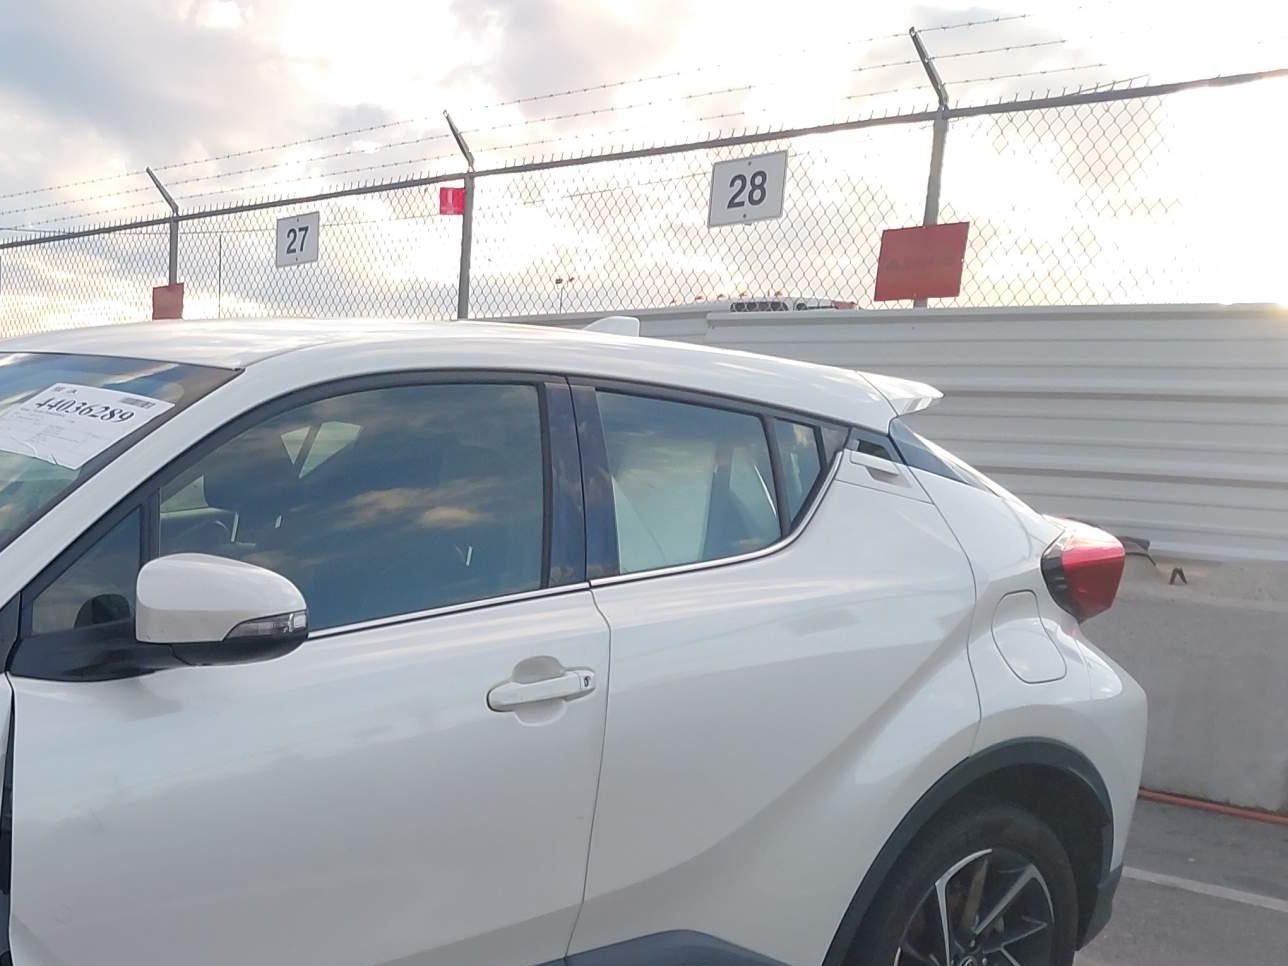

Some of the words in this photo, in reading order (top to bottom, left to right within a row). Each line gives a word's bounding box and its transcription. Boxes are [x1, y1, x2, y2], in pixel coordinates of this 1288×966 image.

[727, 170, 767, 209] 28
[286, 226, 309, 254] 27
[35, 397, 135, 423] 44036289
